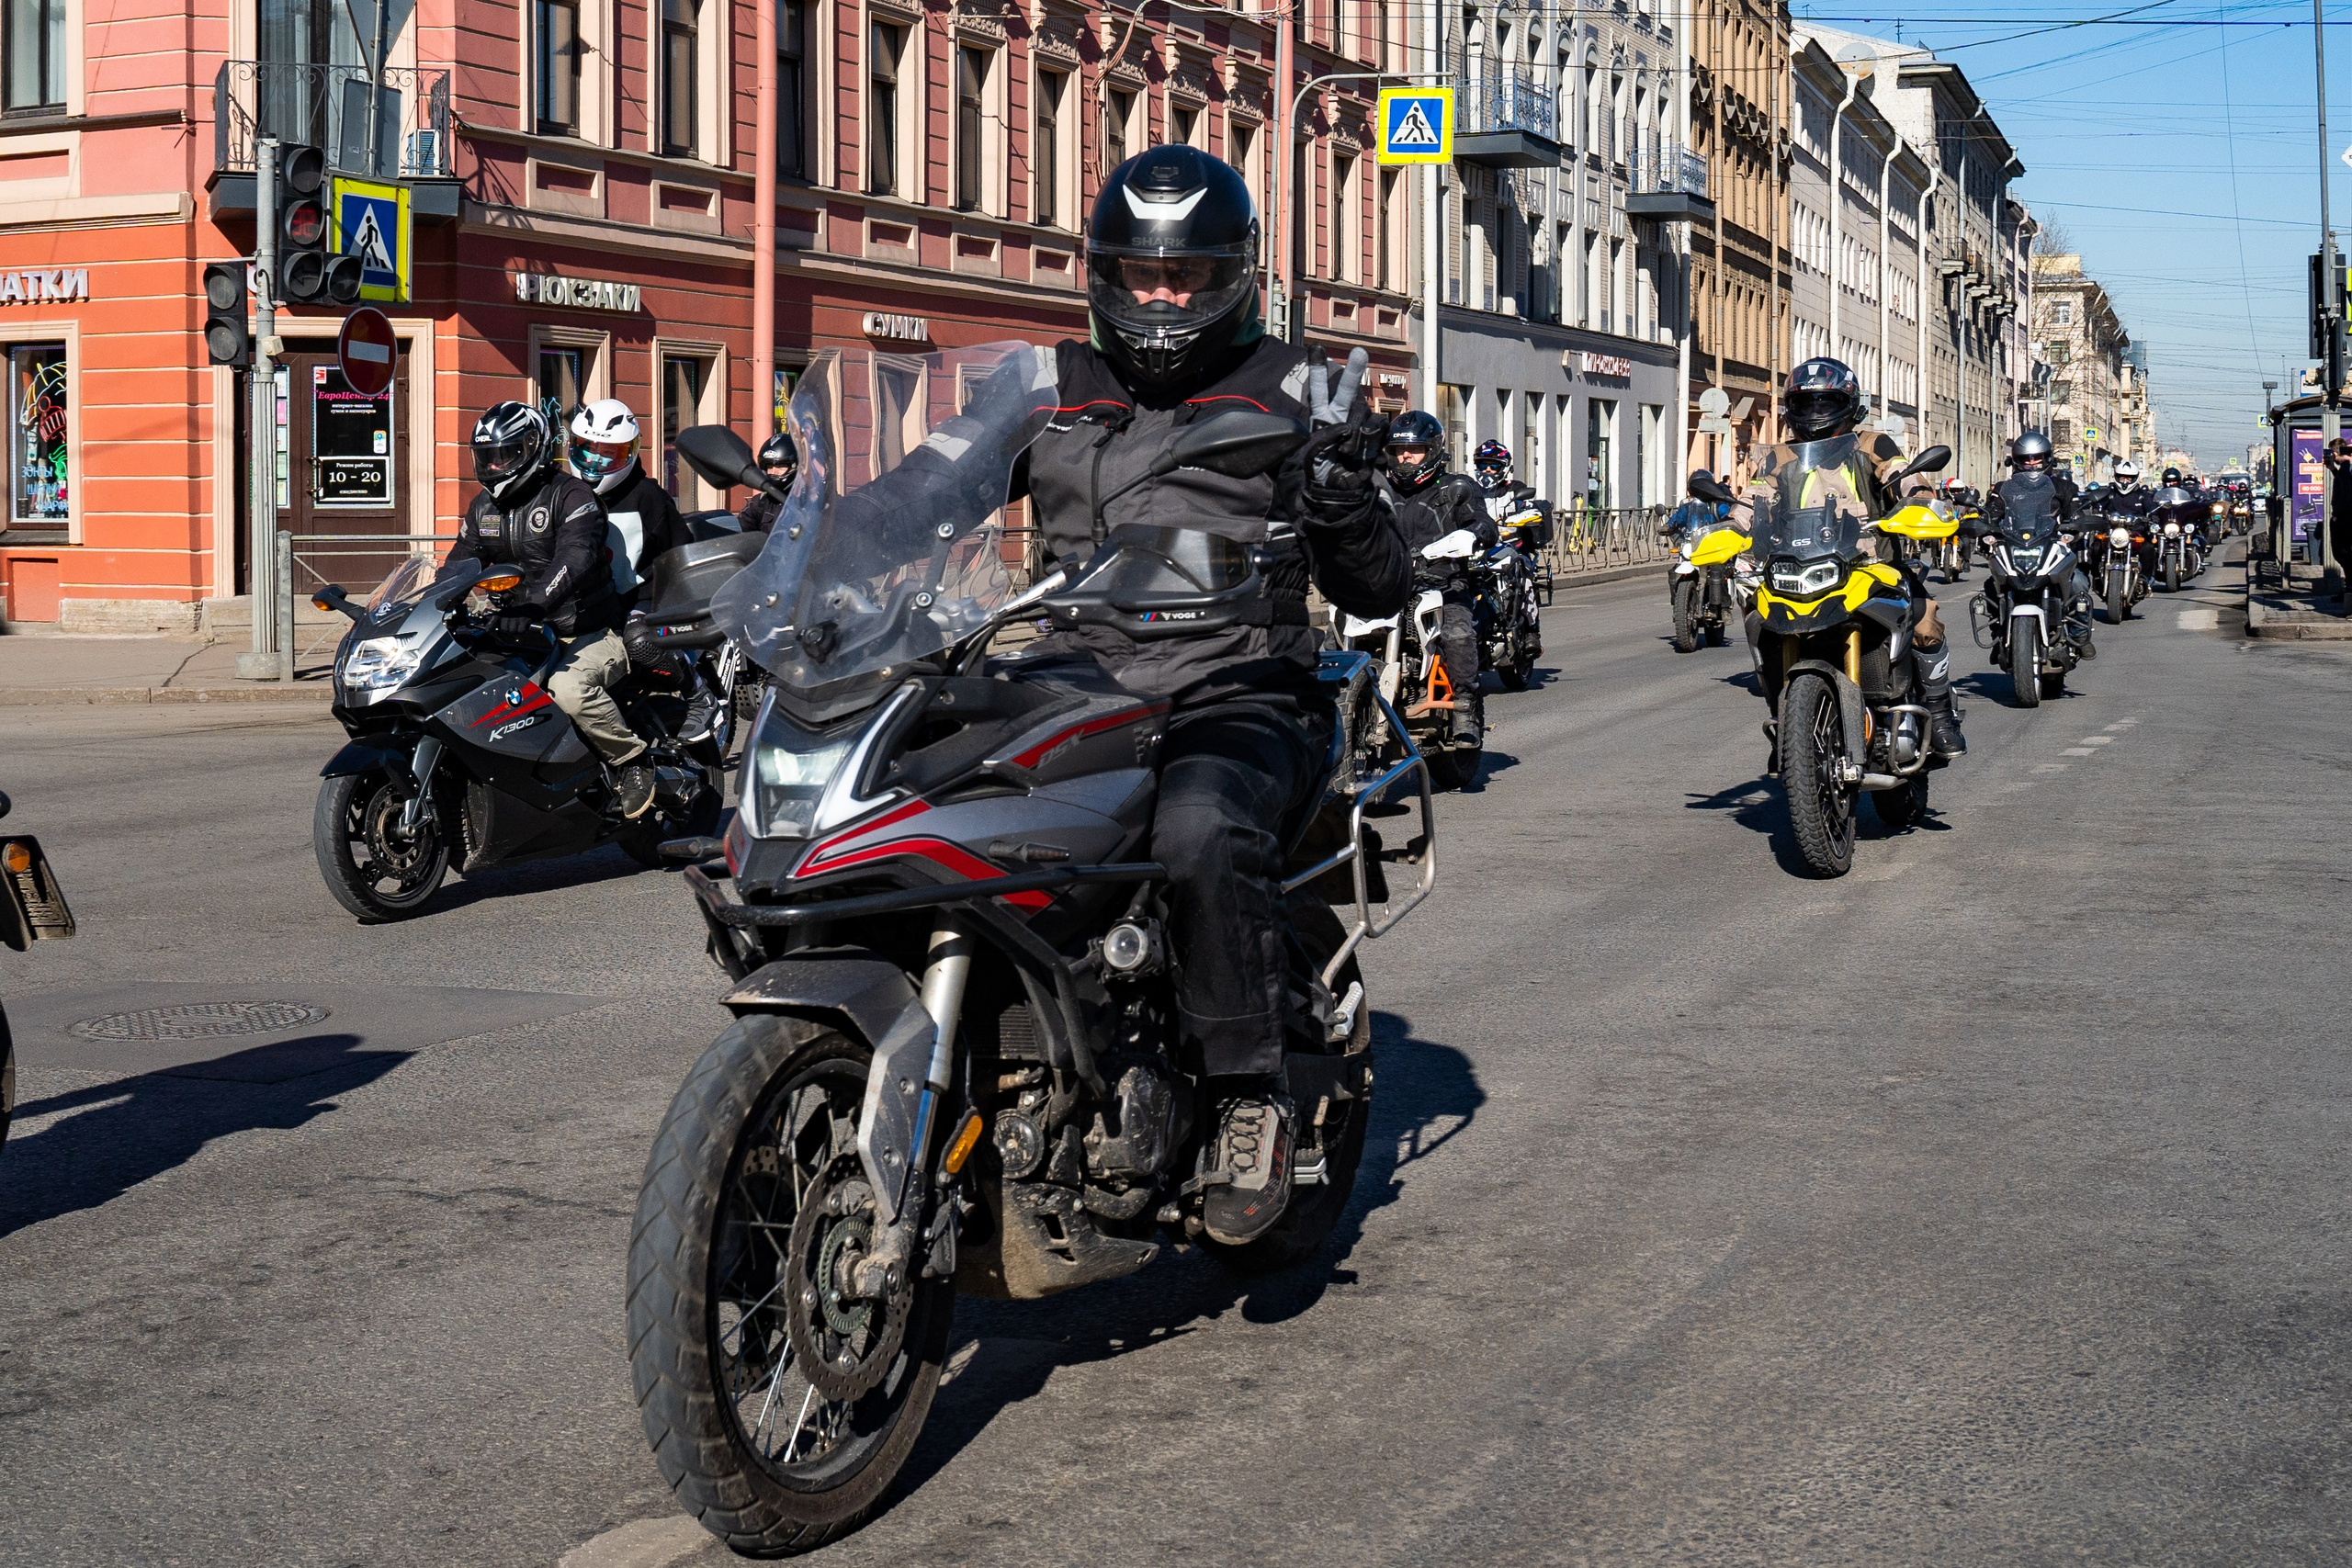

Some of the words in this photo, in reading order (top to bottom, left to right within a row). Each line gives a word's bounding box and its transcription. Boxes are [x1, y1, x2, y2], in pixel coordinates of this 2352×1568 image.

[1131, 237, 1186, 247] SHARK
[0, 269, 88, 302] АТКИ
[516, 273, 640, 312] РЮКЗАКИ
[863, 312, 928, 341] СУМКИ
[21, 466, 53, 478] ЗОНТЫ
[329, 471, 346, 483] 10
[361, 471, 381, 483] 20
[1792, 537, 1811, 547] GS
[1171, 611, 1196, 620] VOGE
[676, 625, 693, 633] VOGE
